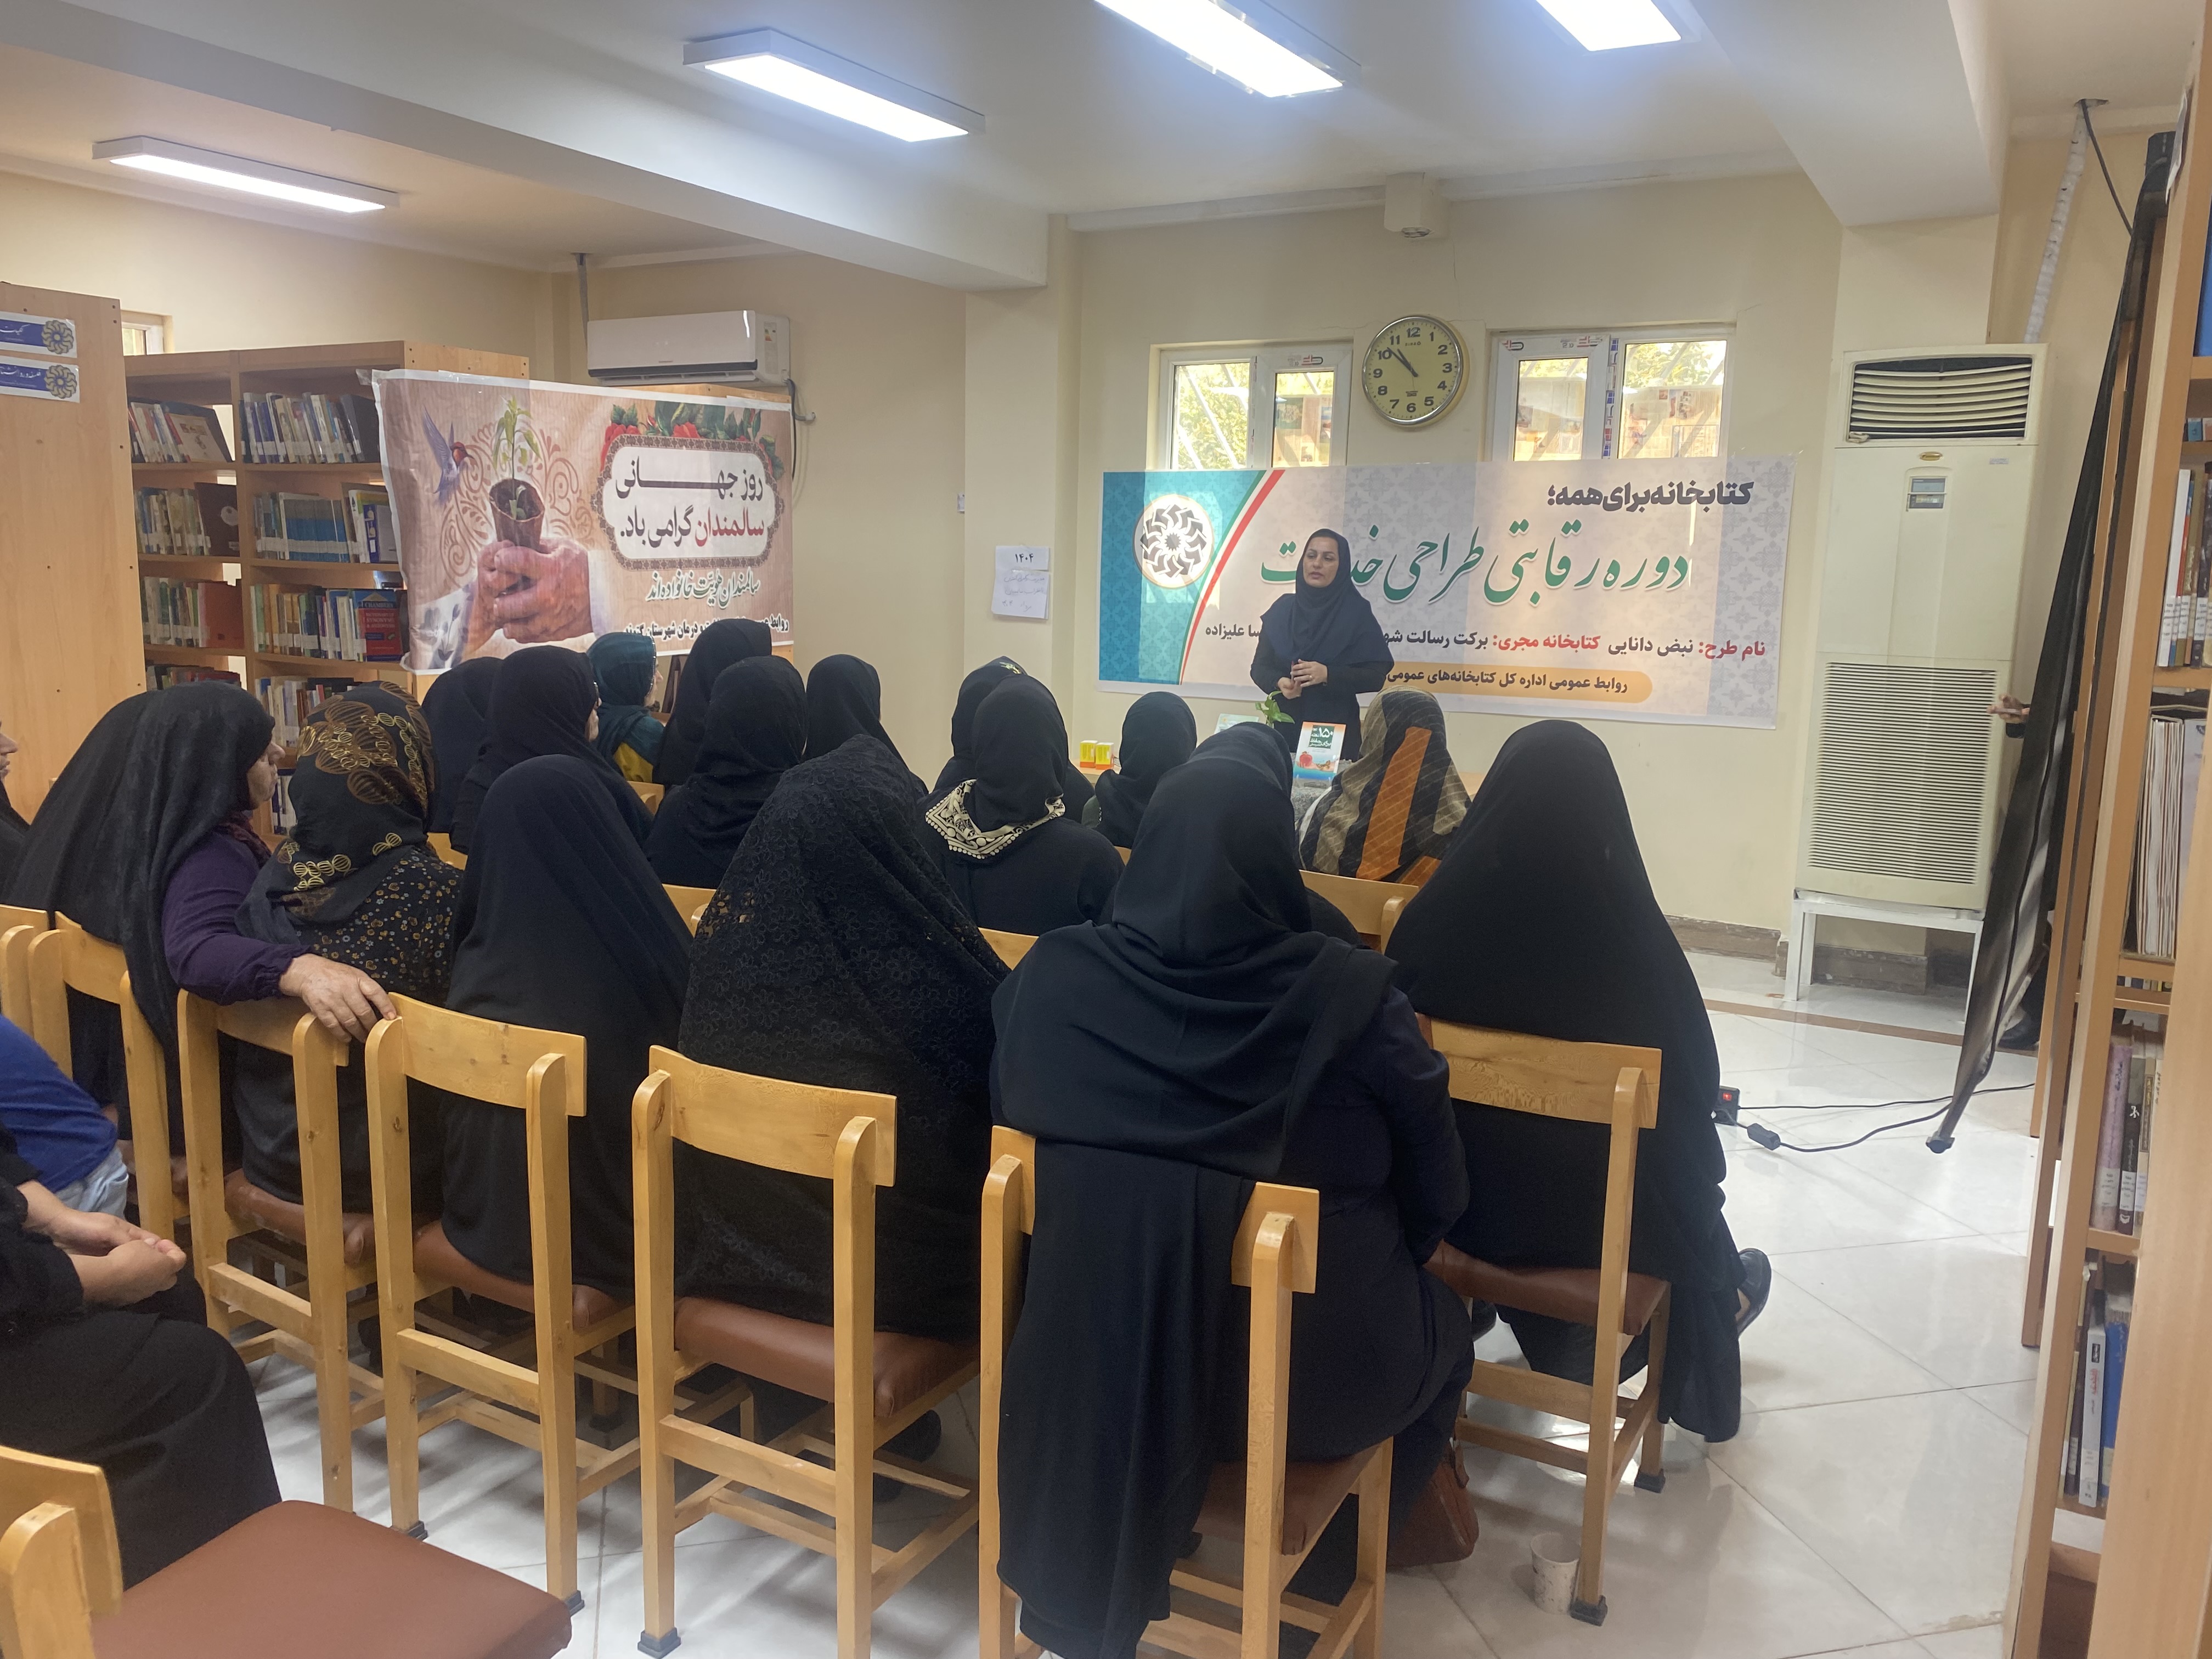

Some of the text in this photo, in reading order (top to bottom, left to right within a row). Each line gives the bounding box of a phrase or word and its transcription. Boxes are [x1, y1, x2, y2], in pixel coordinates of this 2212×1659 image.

[1390, 335, 1400, 345] 11
[1406, 327, 1420, 338] 12
[1429, 332, 1434, 341] 1
[1378, 349, 1392, 360] 10
[1437, 345, 1448, 355] 2
[1373, 368, 1383, 378] 9
[1442, 363, 1452, 373] 3
[1378, 386, 1387, 396] 8
[1437, 381, 1447, 390] 4
[1390, 399, 1400, 409] 7
[1407, 403, 1416, 413] 6
[1424, 396, 1434, 406] 5
[741, 469, 763, 501] روز
[1547, 480, 1754, 513] کتابخانه برای همه؛
[620, 504, 764, 548] سالمندان گرامی باد.
[1015, 553, 1034, 563] ۱۴۰۴
[1261, 518, 1688, 606] دوره رقابتی طراحی خدت
[719, 567, 760, 608] سالمندان
[678, 621, 698, 639] درمان
[770, 614, 788, 631] روابط
[647, 622, 676, 640] شهرستان
[1205, 623, 1244, 640] علیزاده
[1407, 630, 1450, 648] رسالت
[1454, 631, 1488, 650] برکت
[1493, 634, 1539, 652] مجری:
[1542, 634, 1601, 653] کتابخانه
[1607, 636, 1654, 655] دانایی
[1657, 638, 1694, 657] نبض
[1698, 640, 1738, 659] طرح:
[1742, 641, 1765, 662] نام
[1387, 671, 1425, 683] عمومی
[1499, 672, 1517, 687] کل
[1519, 674, 1547, 687] اداره
[1549, 677, 1591, 691] عمومی
[1594, 676, 1628, 693] روابط
[1318, 727, 1333, 738] ۱۵۰
